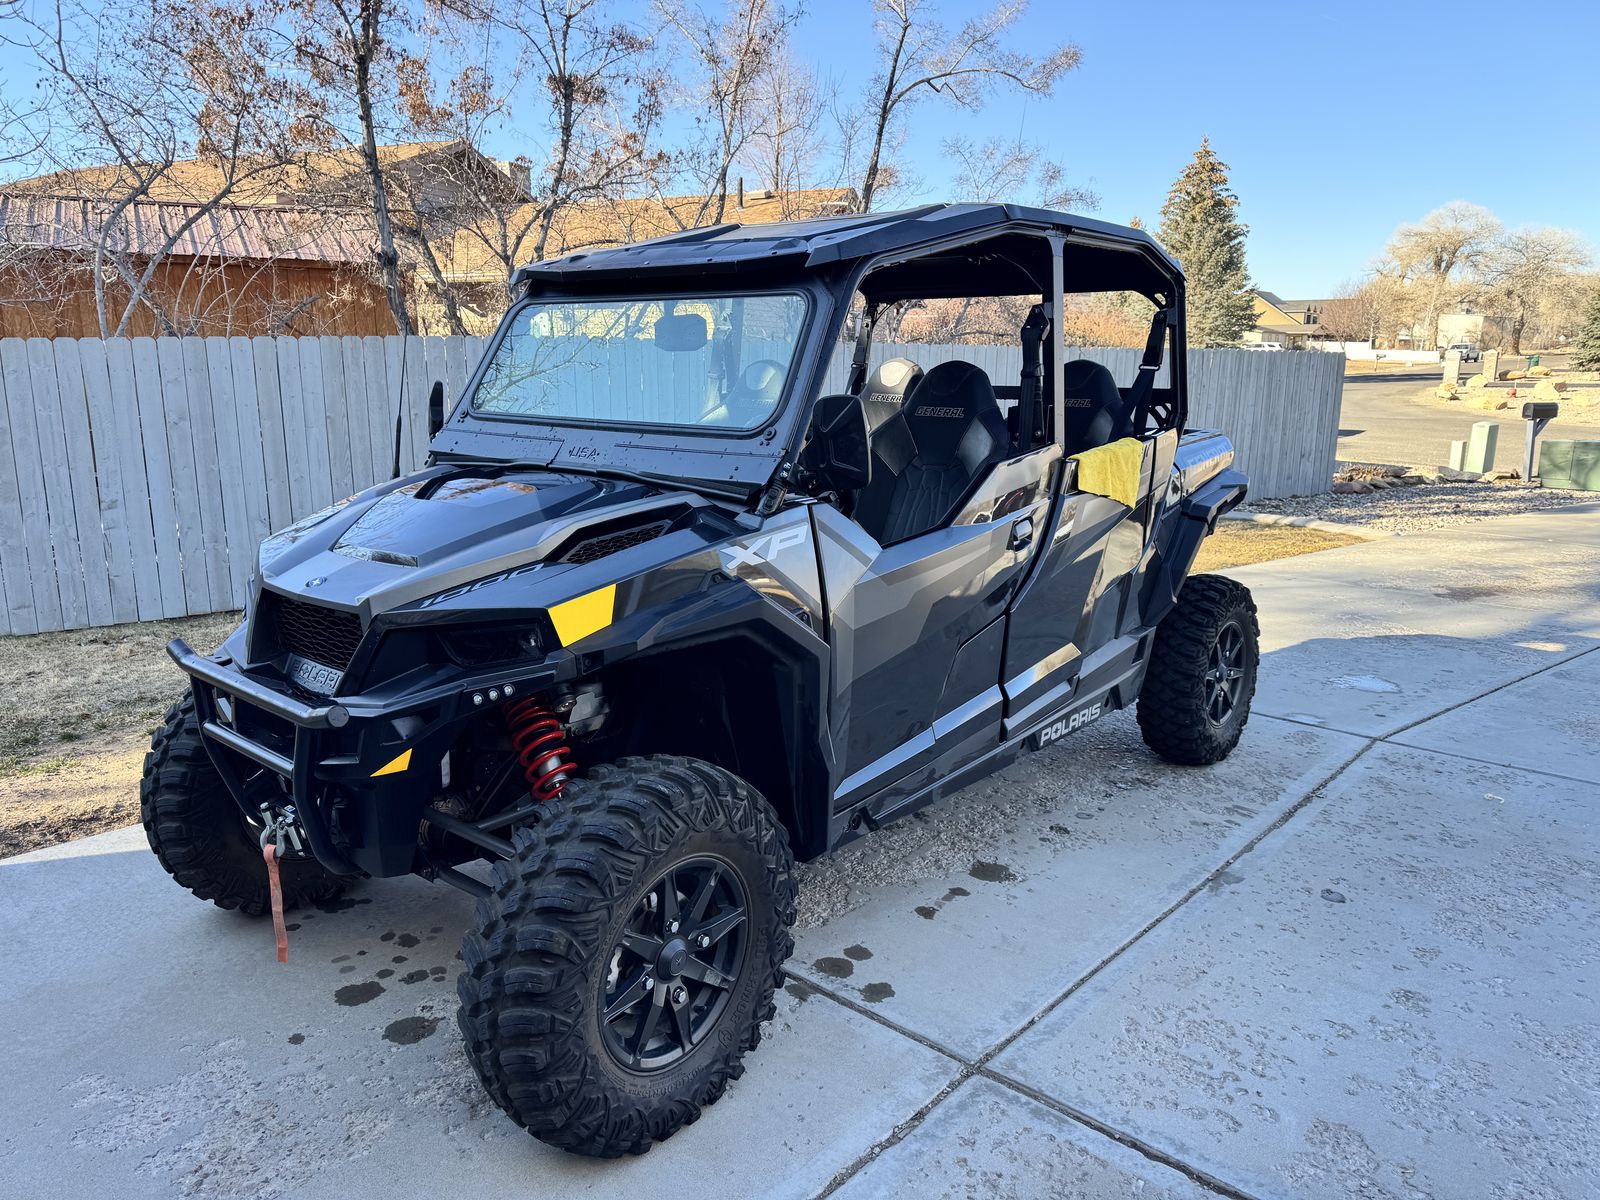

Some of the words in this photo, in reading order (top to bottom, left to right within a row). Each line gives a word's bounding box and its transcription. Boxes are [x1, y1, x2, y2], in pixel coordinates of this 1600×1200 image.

[915, 405, 965, 418] GENERAL
[719, 522, 809, 570] XP
[420, 562, 545, 609] 1000
[1040, 702, 1102, 747] POLARIS
